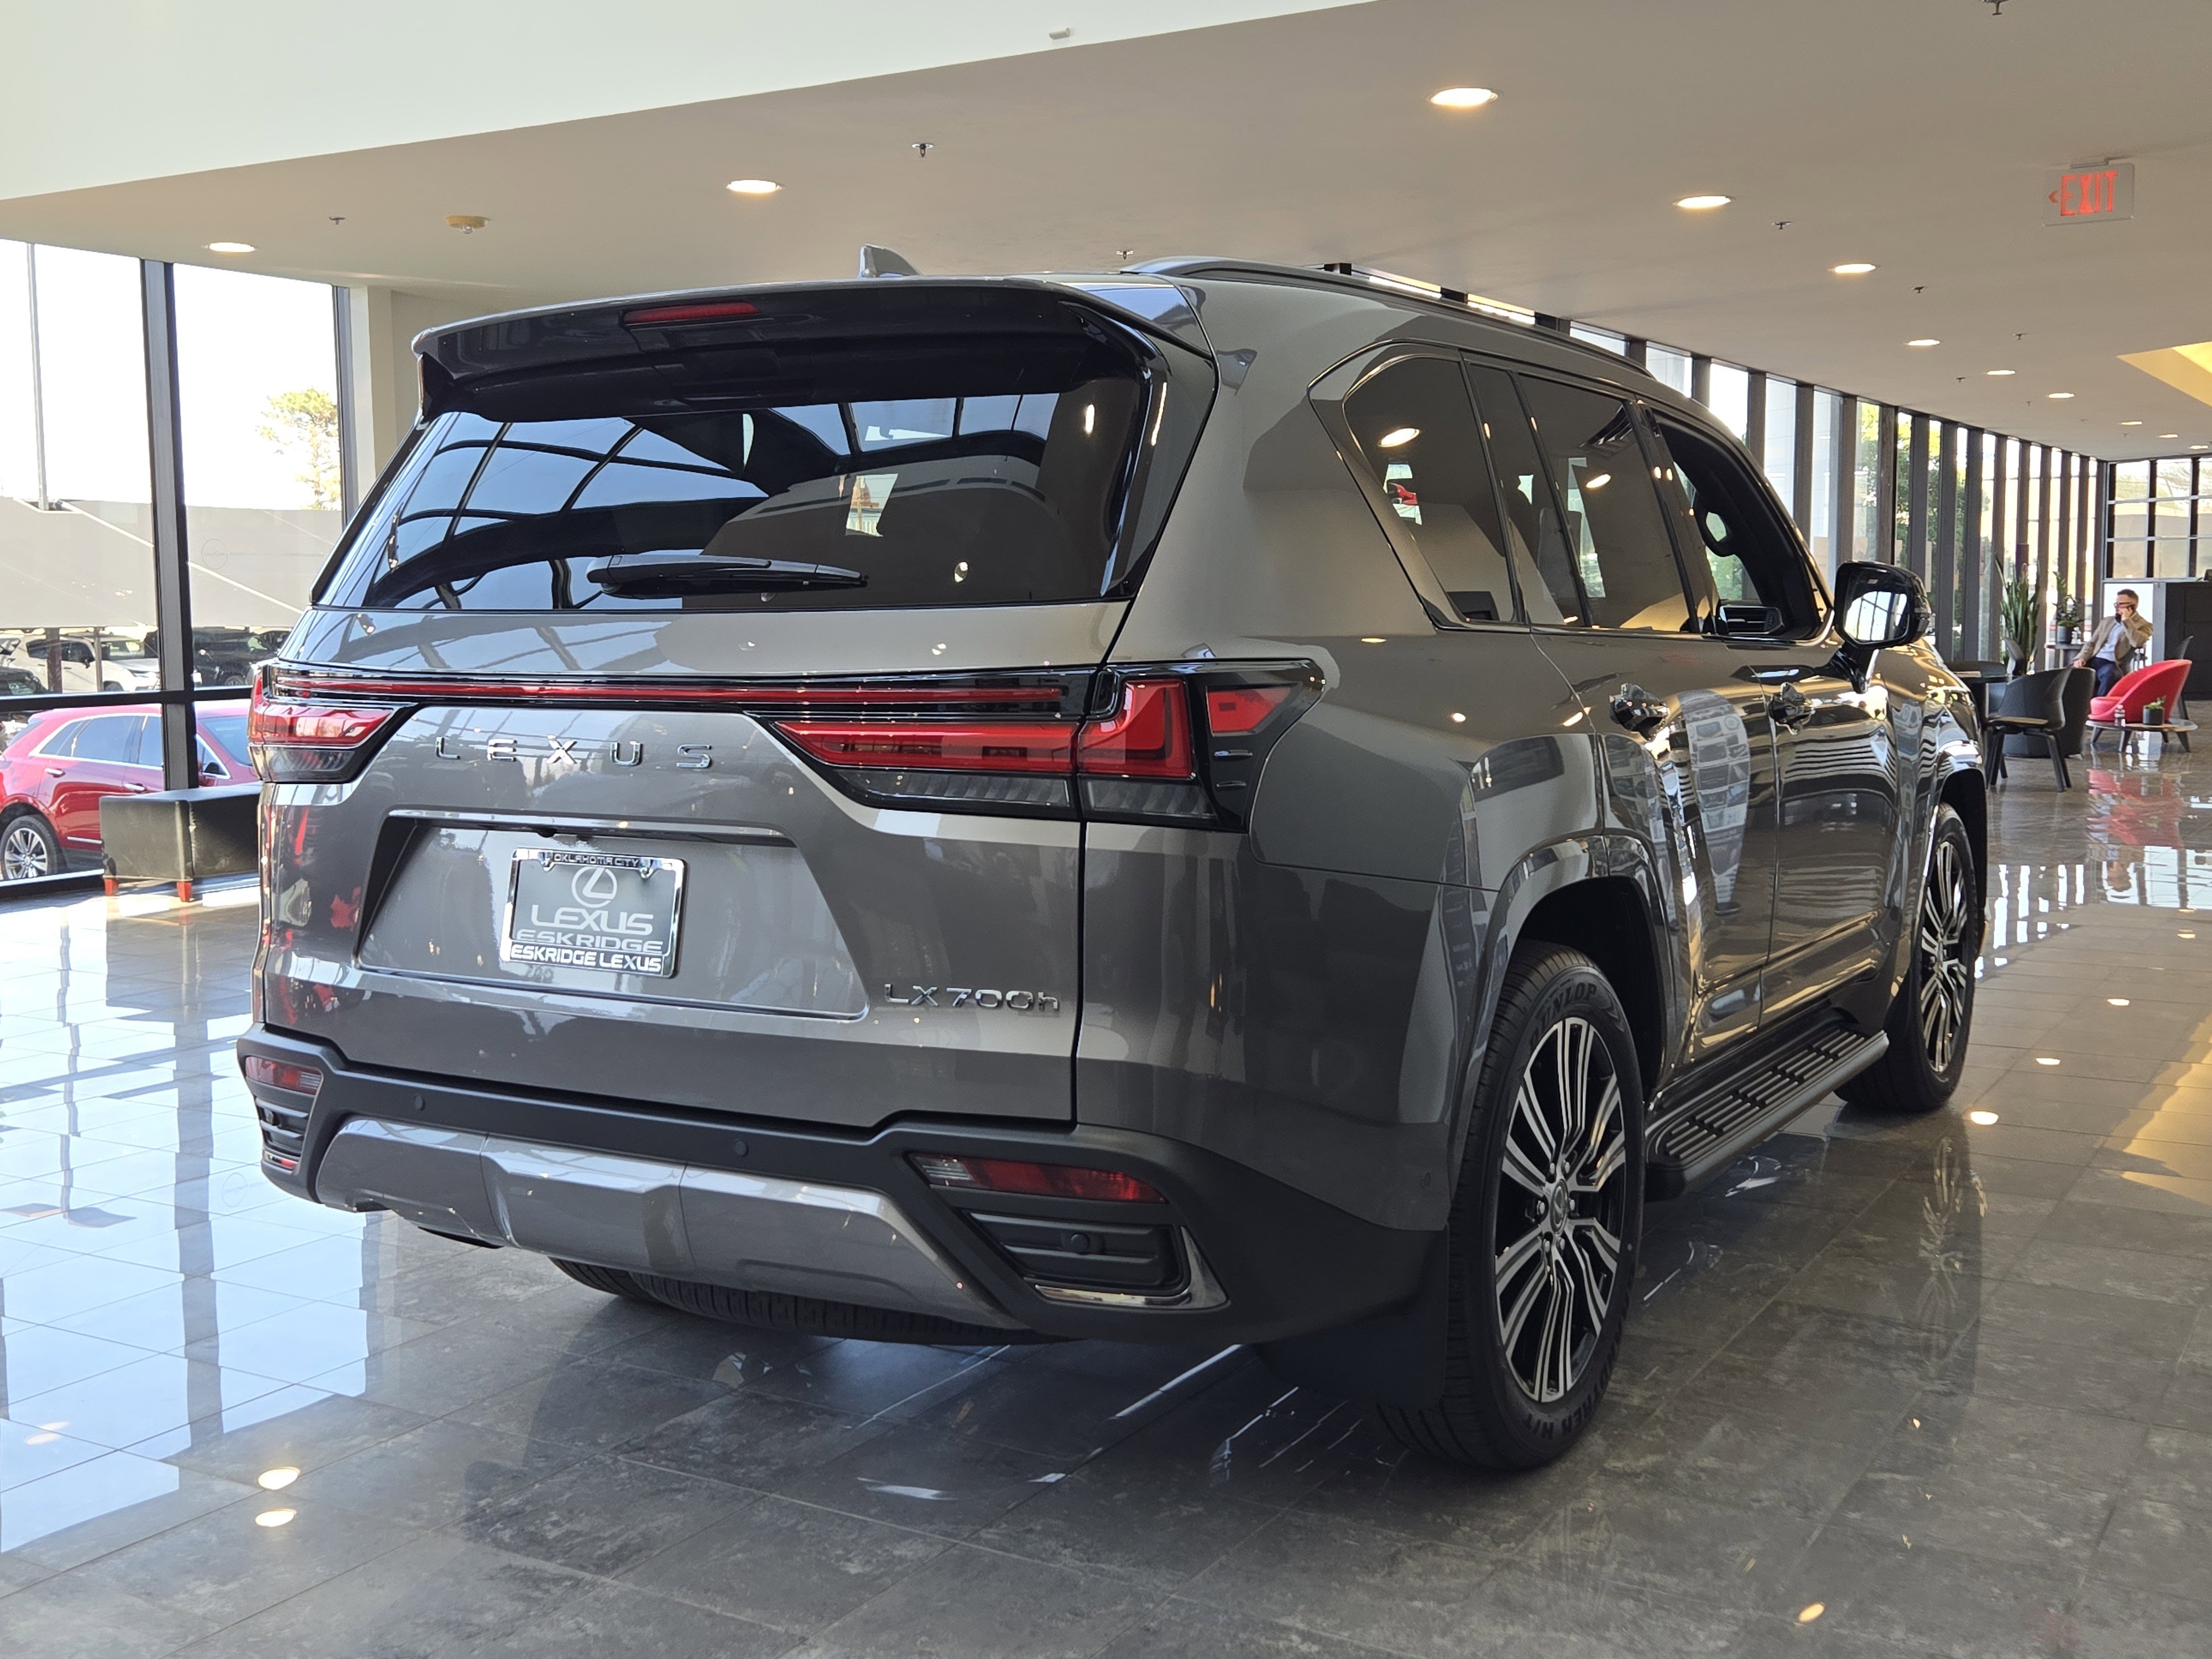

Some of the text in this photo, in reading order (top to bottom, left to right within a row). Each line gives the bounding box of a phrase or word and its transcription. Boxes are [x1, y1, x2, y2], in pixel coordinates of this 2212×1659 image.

[2060, 170, 2119, 216] EXIT
[435, 736, 713, 768] LEXUS
[554, 853, 640, 867] OKLAHOMA CITY
[531, 905, 654, 936] LEXUS
[516, 929, 663, 954] ESKRIDGE
[510, 945, 662, 972] ESKRIDGE LEXUS
[884, 983, 1059, 1010] LX 700h
